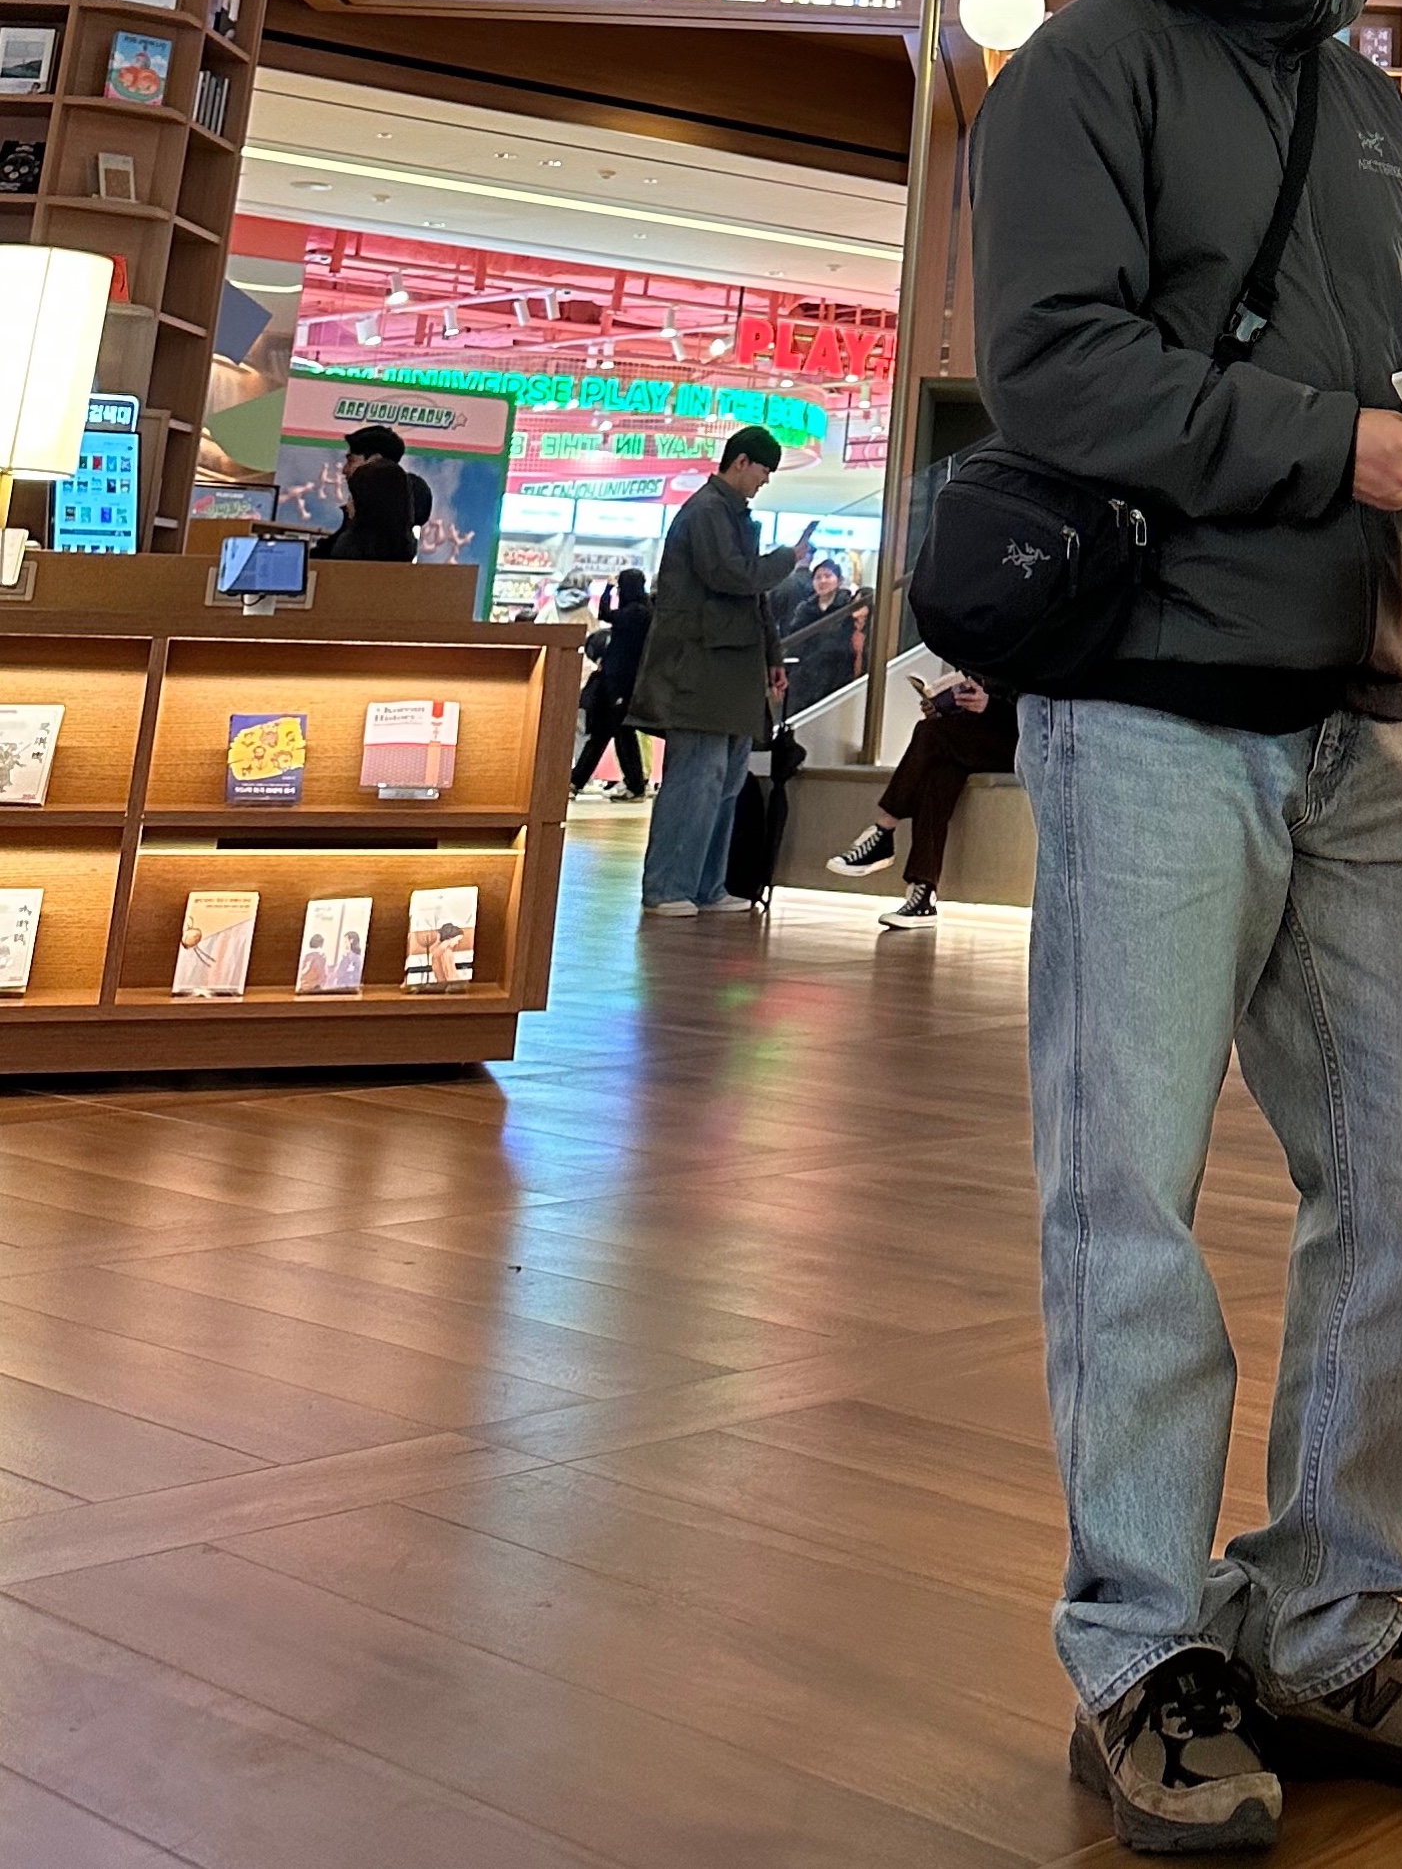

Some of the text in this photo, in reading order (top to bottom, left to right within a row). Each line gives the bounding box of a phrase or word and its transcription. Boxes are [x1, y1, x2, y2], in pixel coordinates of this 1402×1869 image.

[737, 316, 878, 380] PLAY
[336, 399, 455, 427] ARE YOU READY?
[580, 374, 674, 413] PLAY
[675, 382, 714, 419] IN
[715, 387, 766, 424] THE
